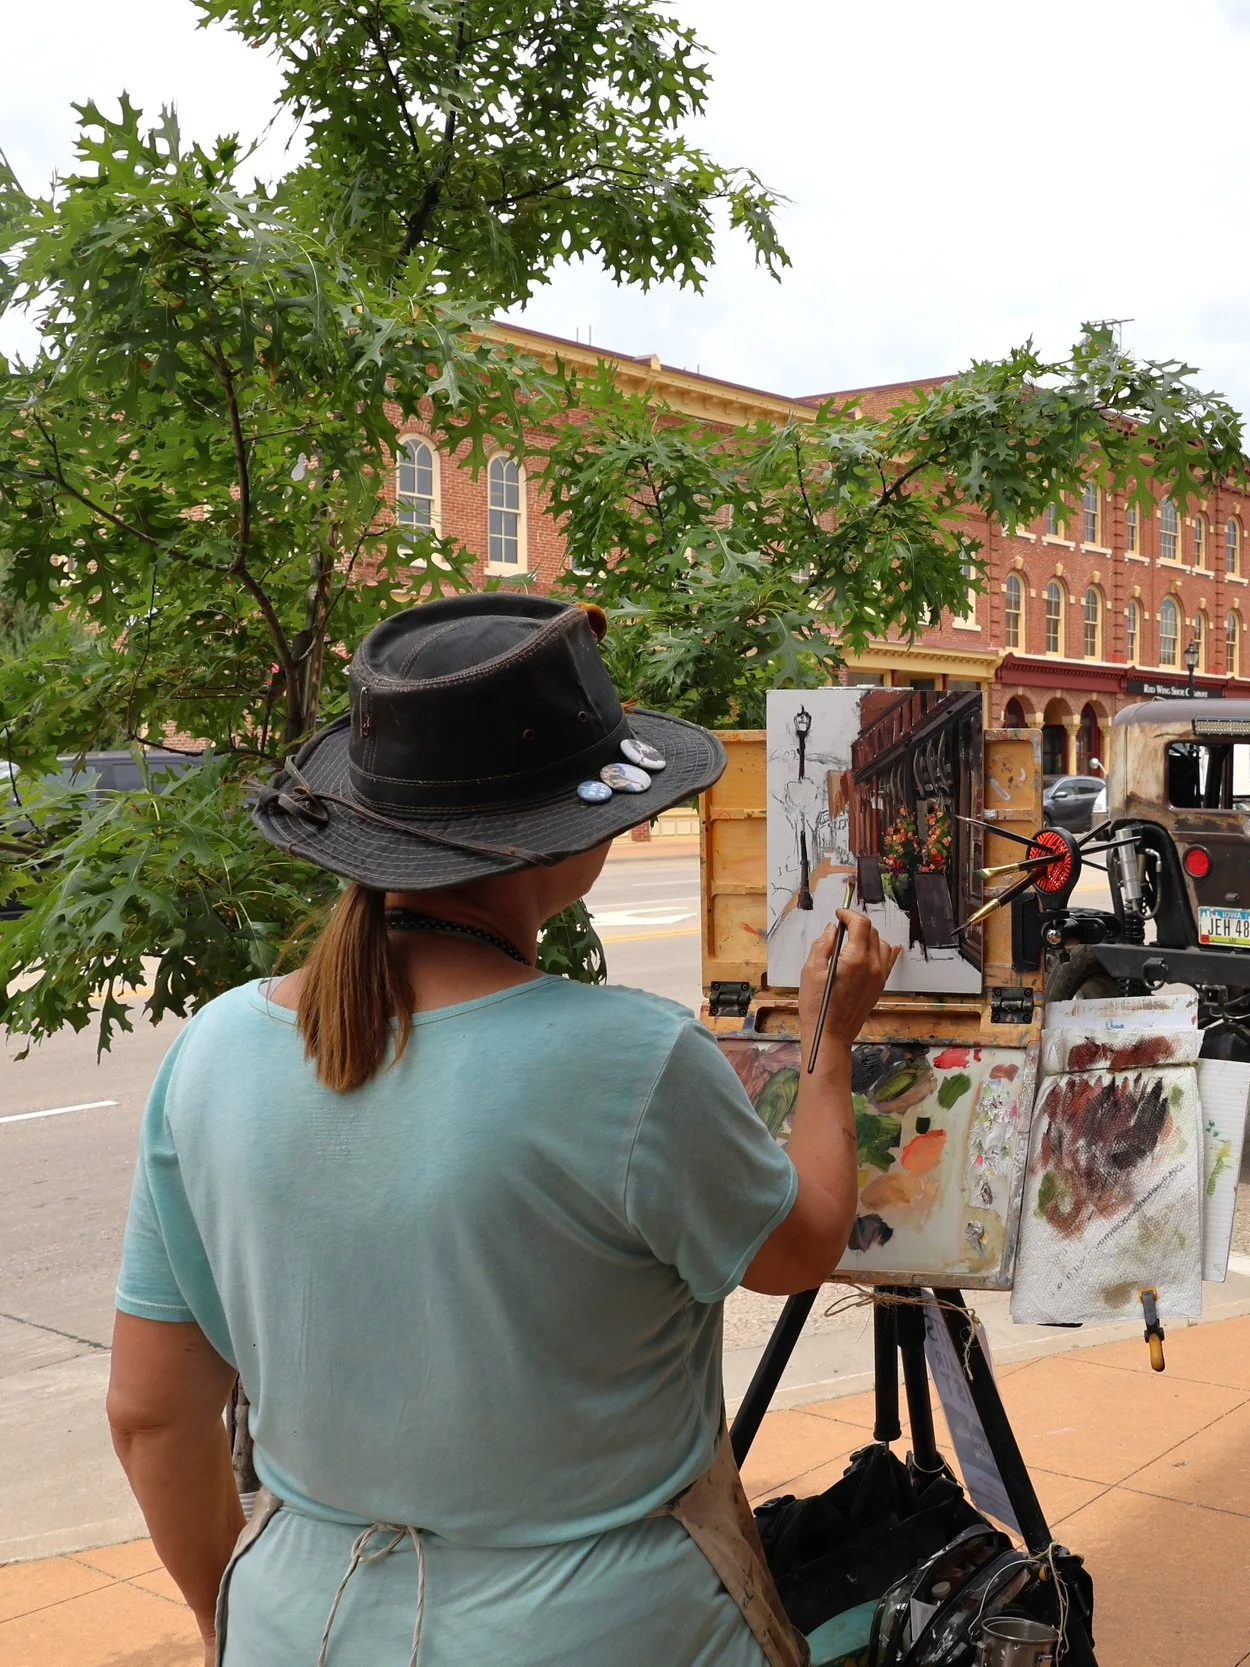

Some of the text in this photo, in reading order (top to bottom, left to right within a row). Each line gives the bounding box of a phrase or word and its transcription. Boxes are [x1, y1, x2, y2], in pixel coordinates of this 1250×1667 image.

[1185, 688, 1208, 698] CMPANY
[1223, 912, 1242, 920] IOWA
[1208, 918, 1231, 937] JEH
